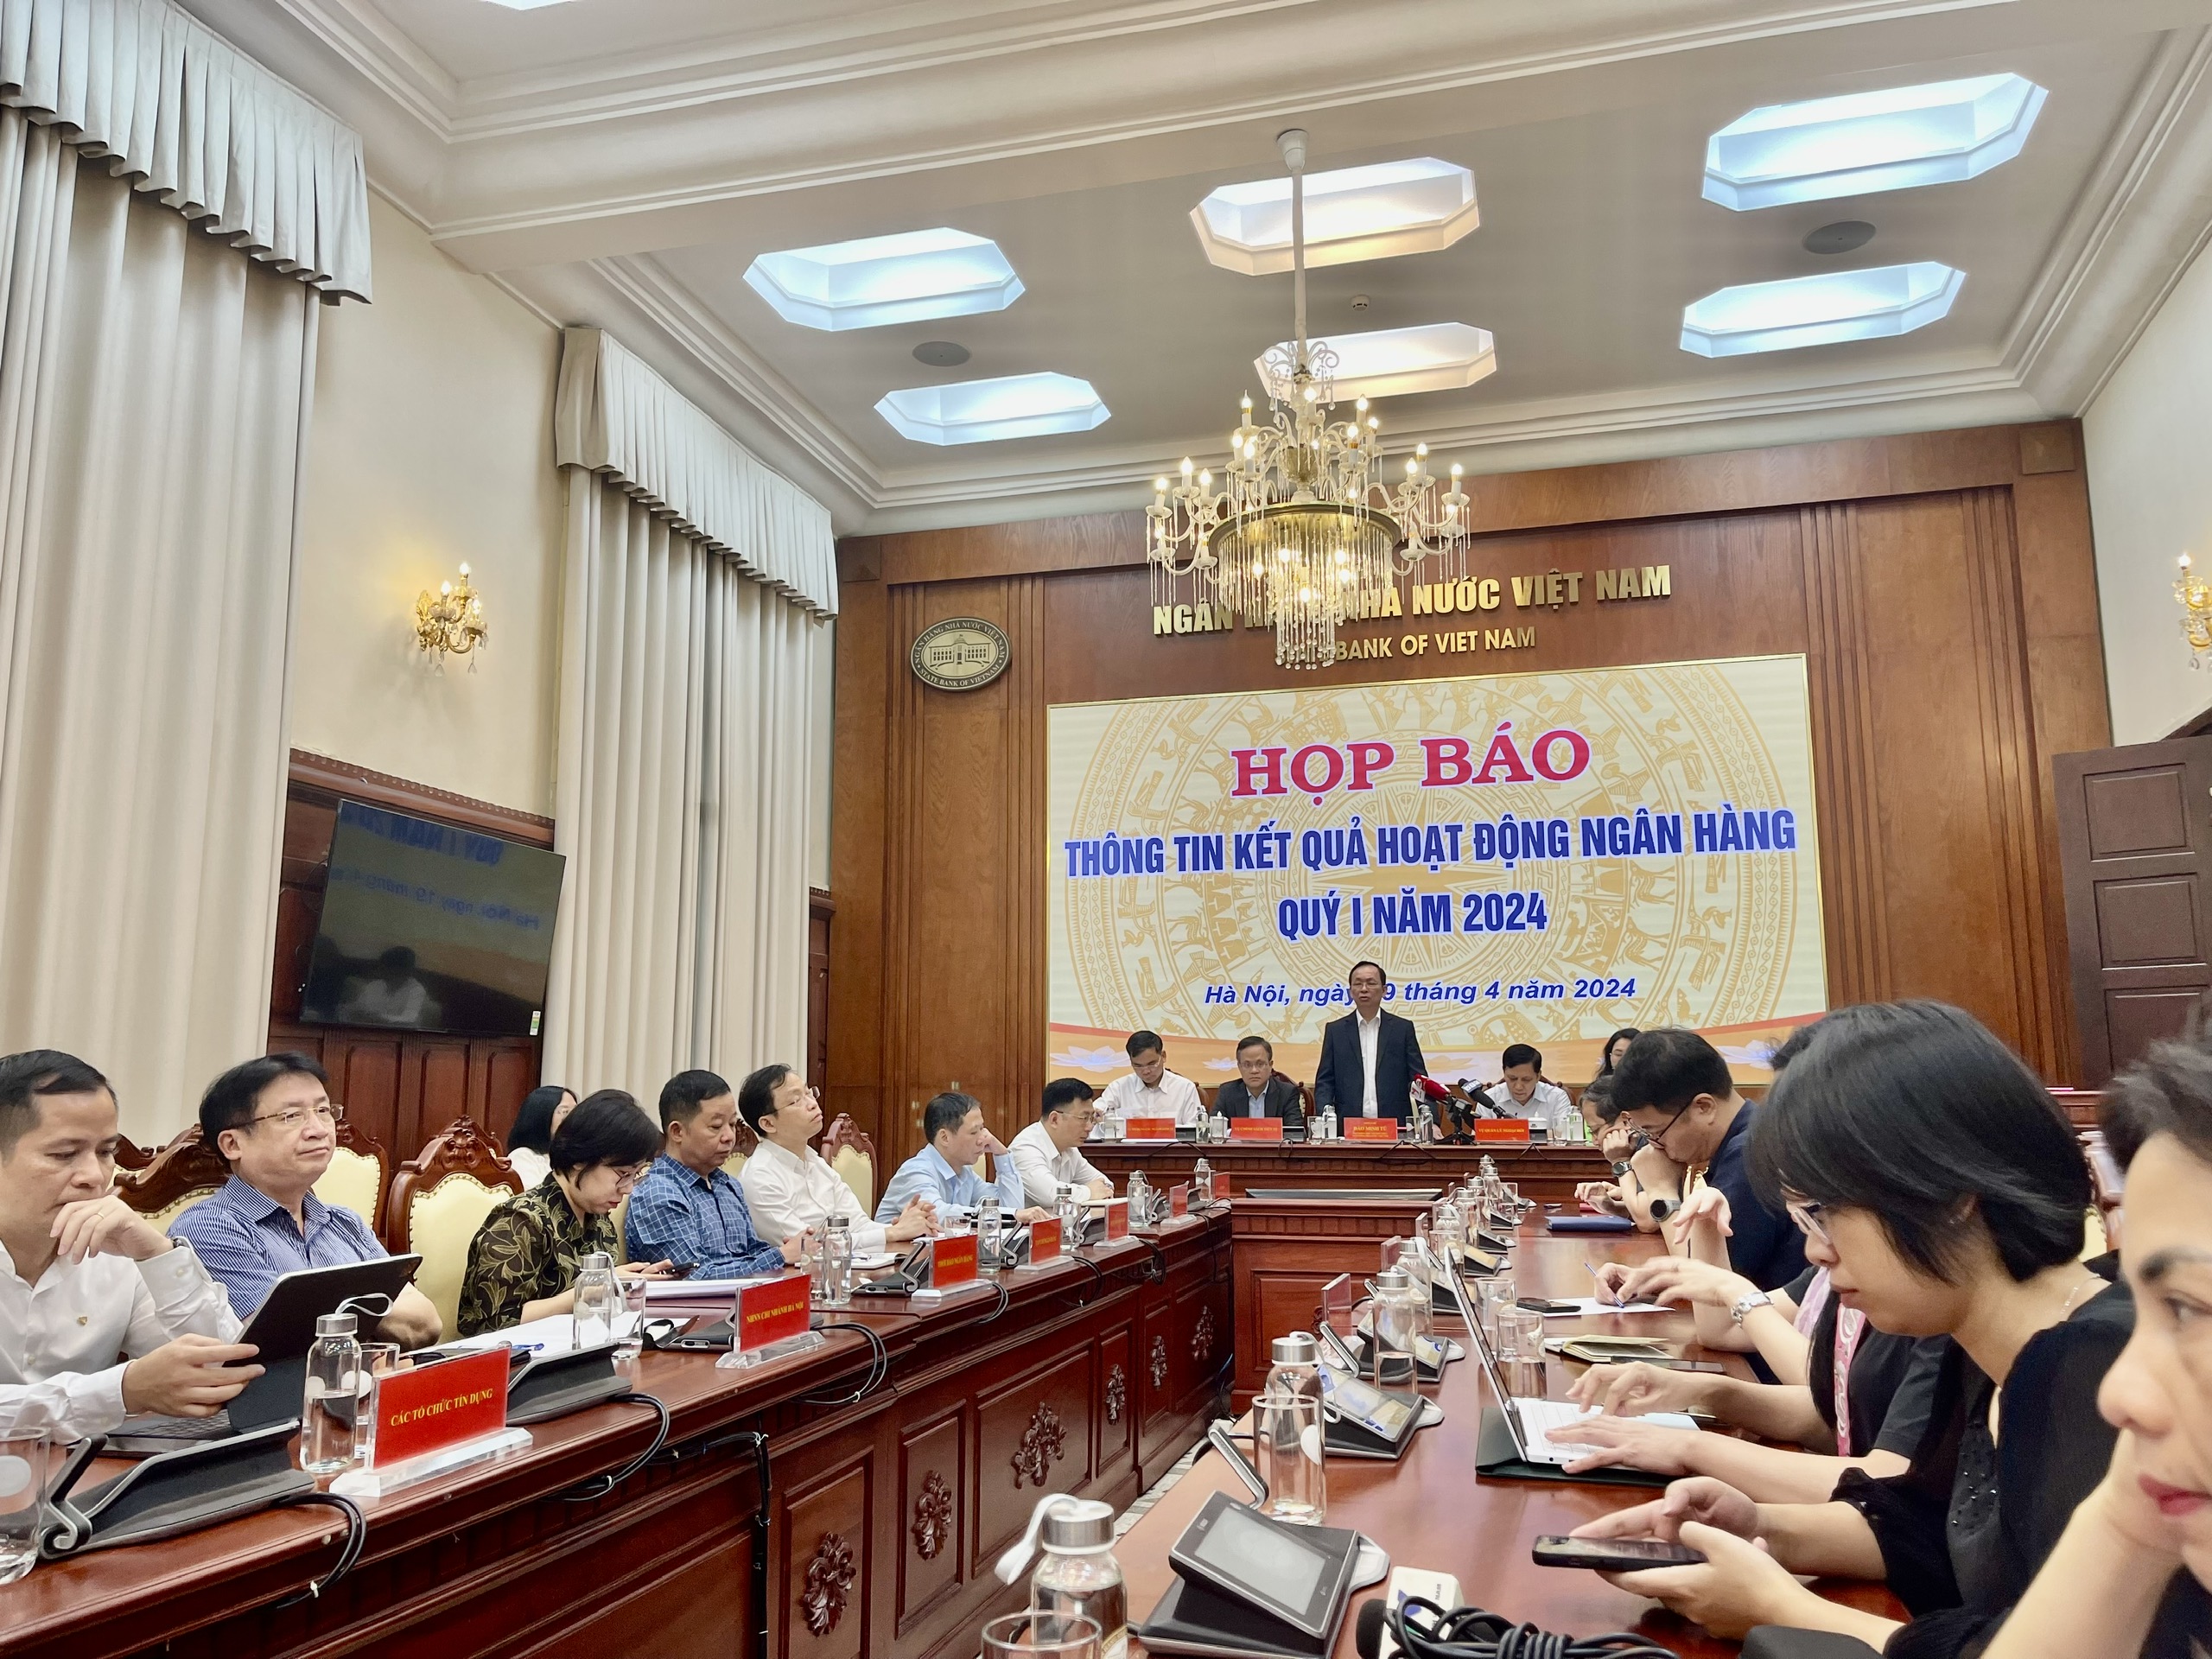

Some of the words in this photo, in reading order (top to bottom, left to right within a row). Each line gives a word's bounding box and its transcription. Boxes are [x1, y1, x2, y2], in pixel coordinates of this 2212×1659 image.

[1153, 597, 1233, 635] NGÂN
[1412, 575, 1500, 615] NƯỚC
[1511, 568, 1583, 610] VIỆT
[1596, 564, 1671, 601] NAM
[1336, 638, 1393, 661] BANK
[1401, 634, 1428, 656] OF
[1434, 630, 1478, 653] VIET
[1484, 626, 1535, 650] NAM
[919, 669, 940, 684] STATE
[939, 678, 958, 687] BANK
[969, 664, 1001, 684] VIETNAM
[1230, 741, 1395, 805] HỌP
[1421, 721, 1590, 787] BÁO
[1065, 832, 1164, 876] THÔNG
[1174, 835, 1224, 874] TIN
[1234, 821, 1292, 869] KẾT
[1301, 816, 1367, 871] QUẢ
[1378, 824, 1463, 871] HOẠT
[1473, 814, 1569, 868] ĐỘNG
[1581, 808, 1682, 856] NGÂN
[1694, 803, 1796, 852] HÀNG
[1278, 891, 1341, 940] QUÝ
[1352, 897, 1361, 935] I
[1373, 887, 1452, 934] NĂM
[1464, 892, 1547, 931] 2024
[1205, 986, 1236, 1003] Hà
[1244, 985, 1290, 1007] Nội,
[1300, 982, 1351, 1007] ngày
[1383, 983, 1395, 1001] 9
[1404, 982, 1477, 1004] tháng
[1485, 982, 1499, 1000] 4
[1508, 980, 1564, 999] năm
[1574, 978, 1636, 999] 2024
[391, 1410, 411, 1426] CÁC
[454, 1394, 469, 1408] TÍN
[469, 1389, 493, 1405] DỤNG
